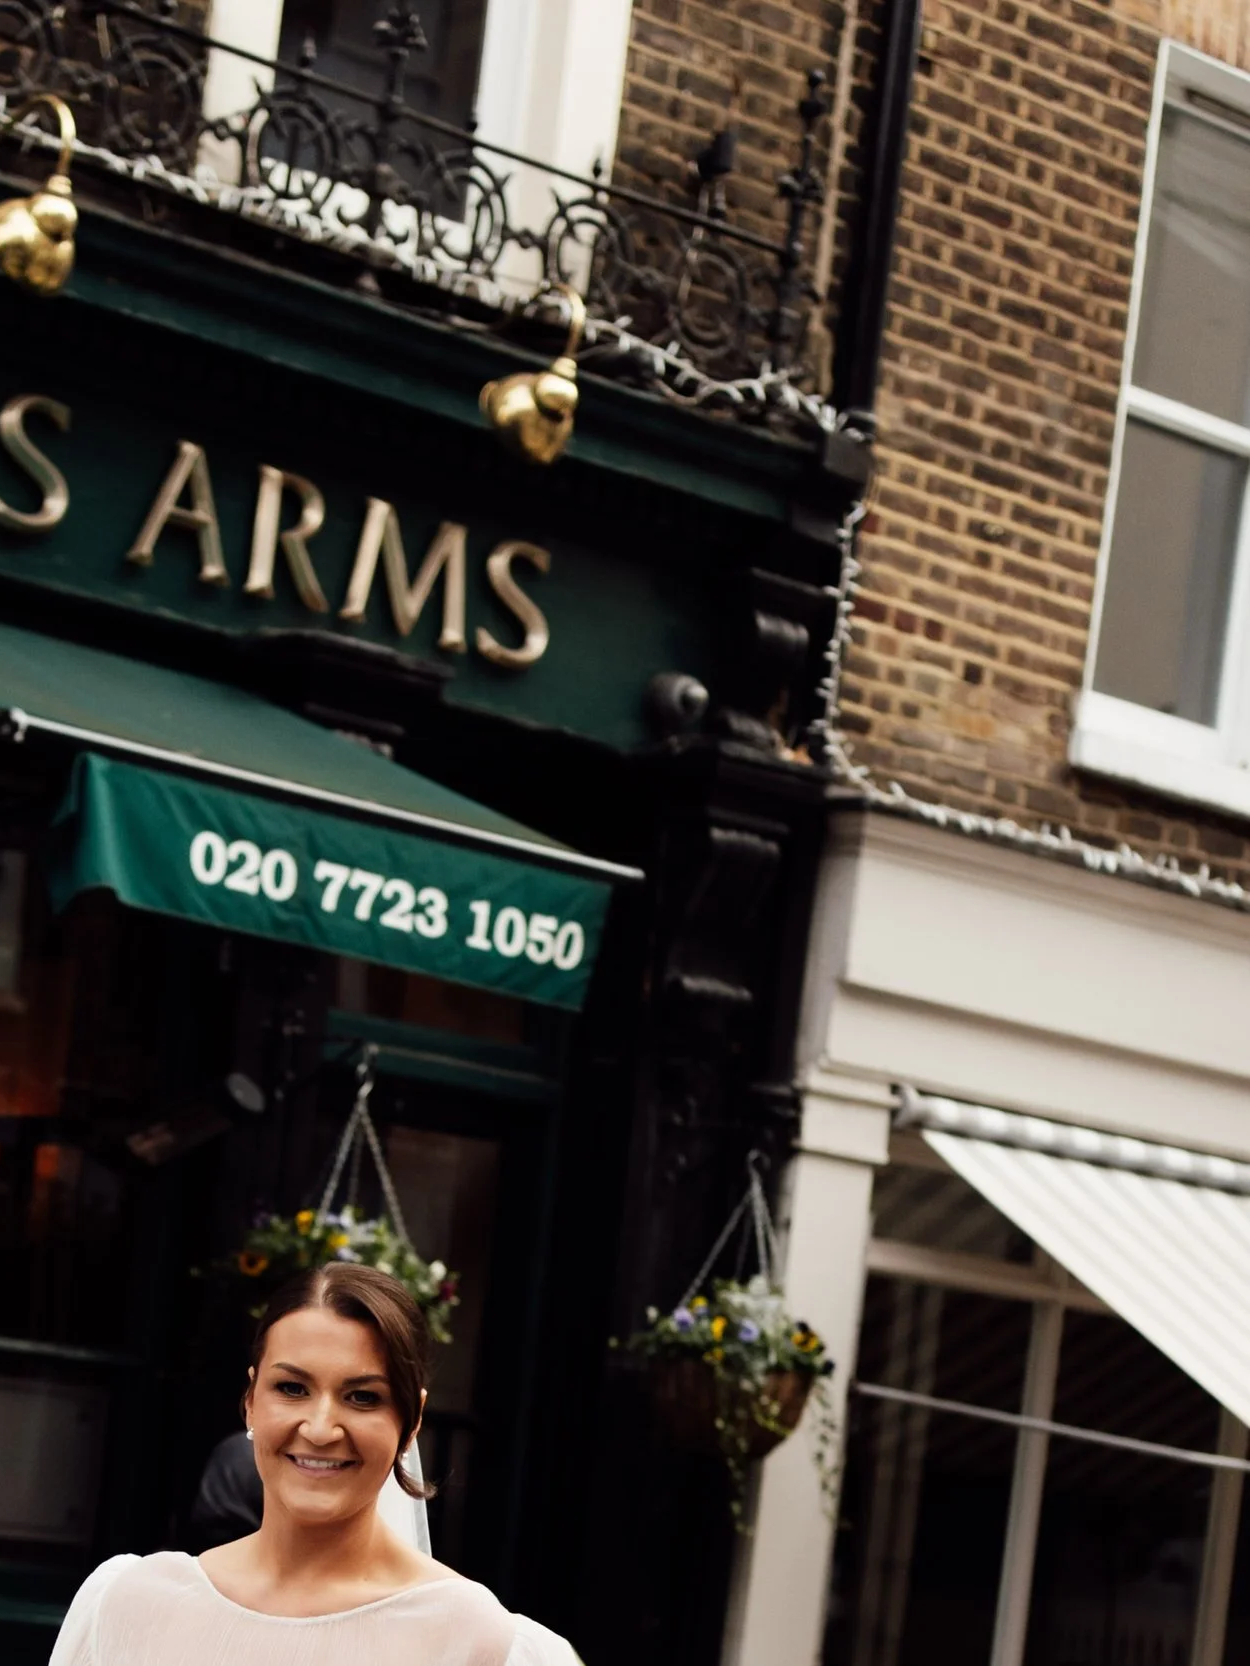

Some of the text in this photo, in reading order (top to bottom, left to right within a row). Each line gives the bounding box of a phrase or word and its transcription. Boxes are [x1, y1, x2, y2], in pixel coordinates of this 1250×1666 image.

[125, 438, 551, 670] ARMS
[189, 830, 585, 970] 020 7723 1050
